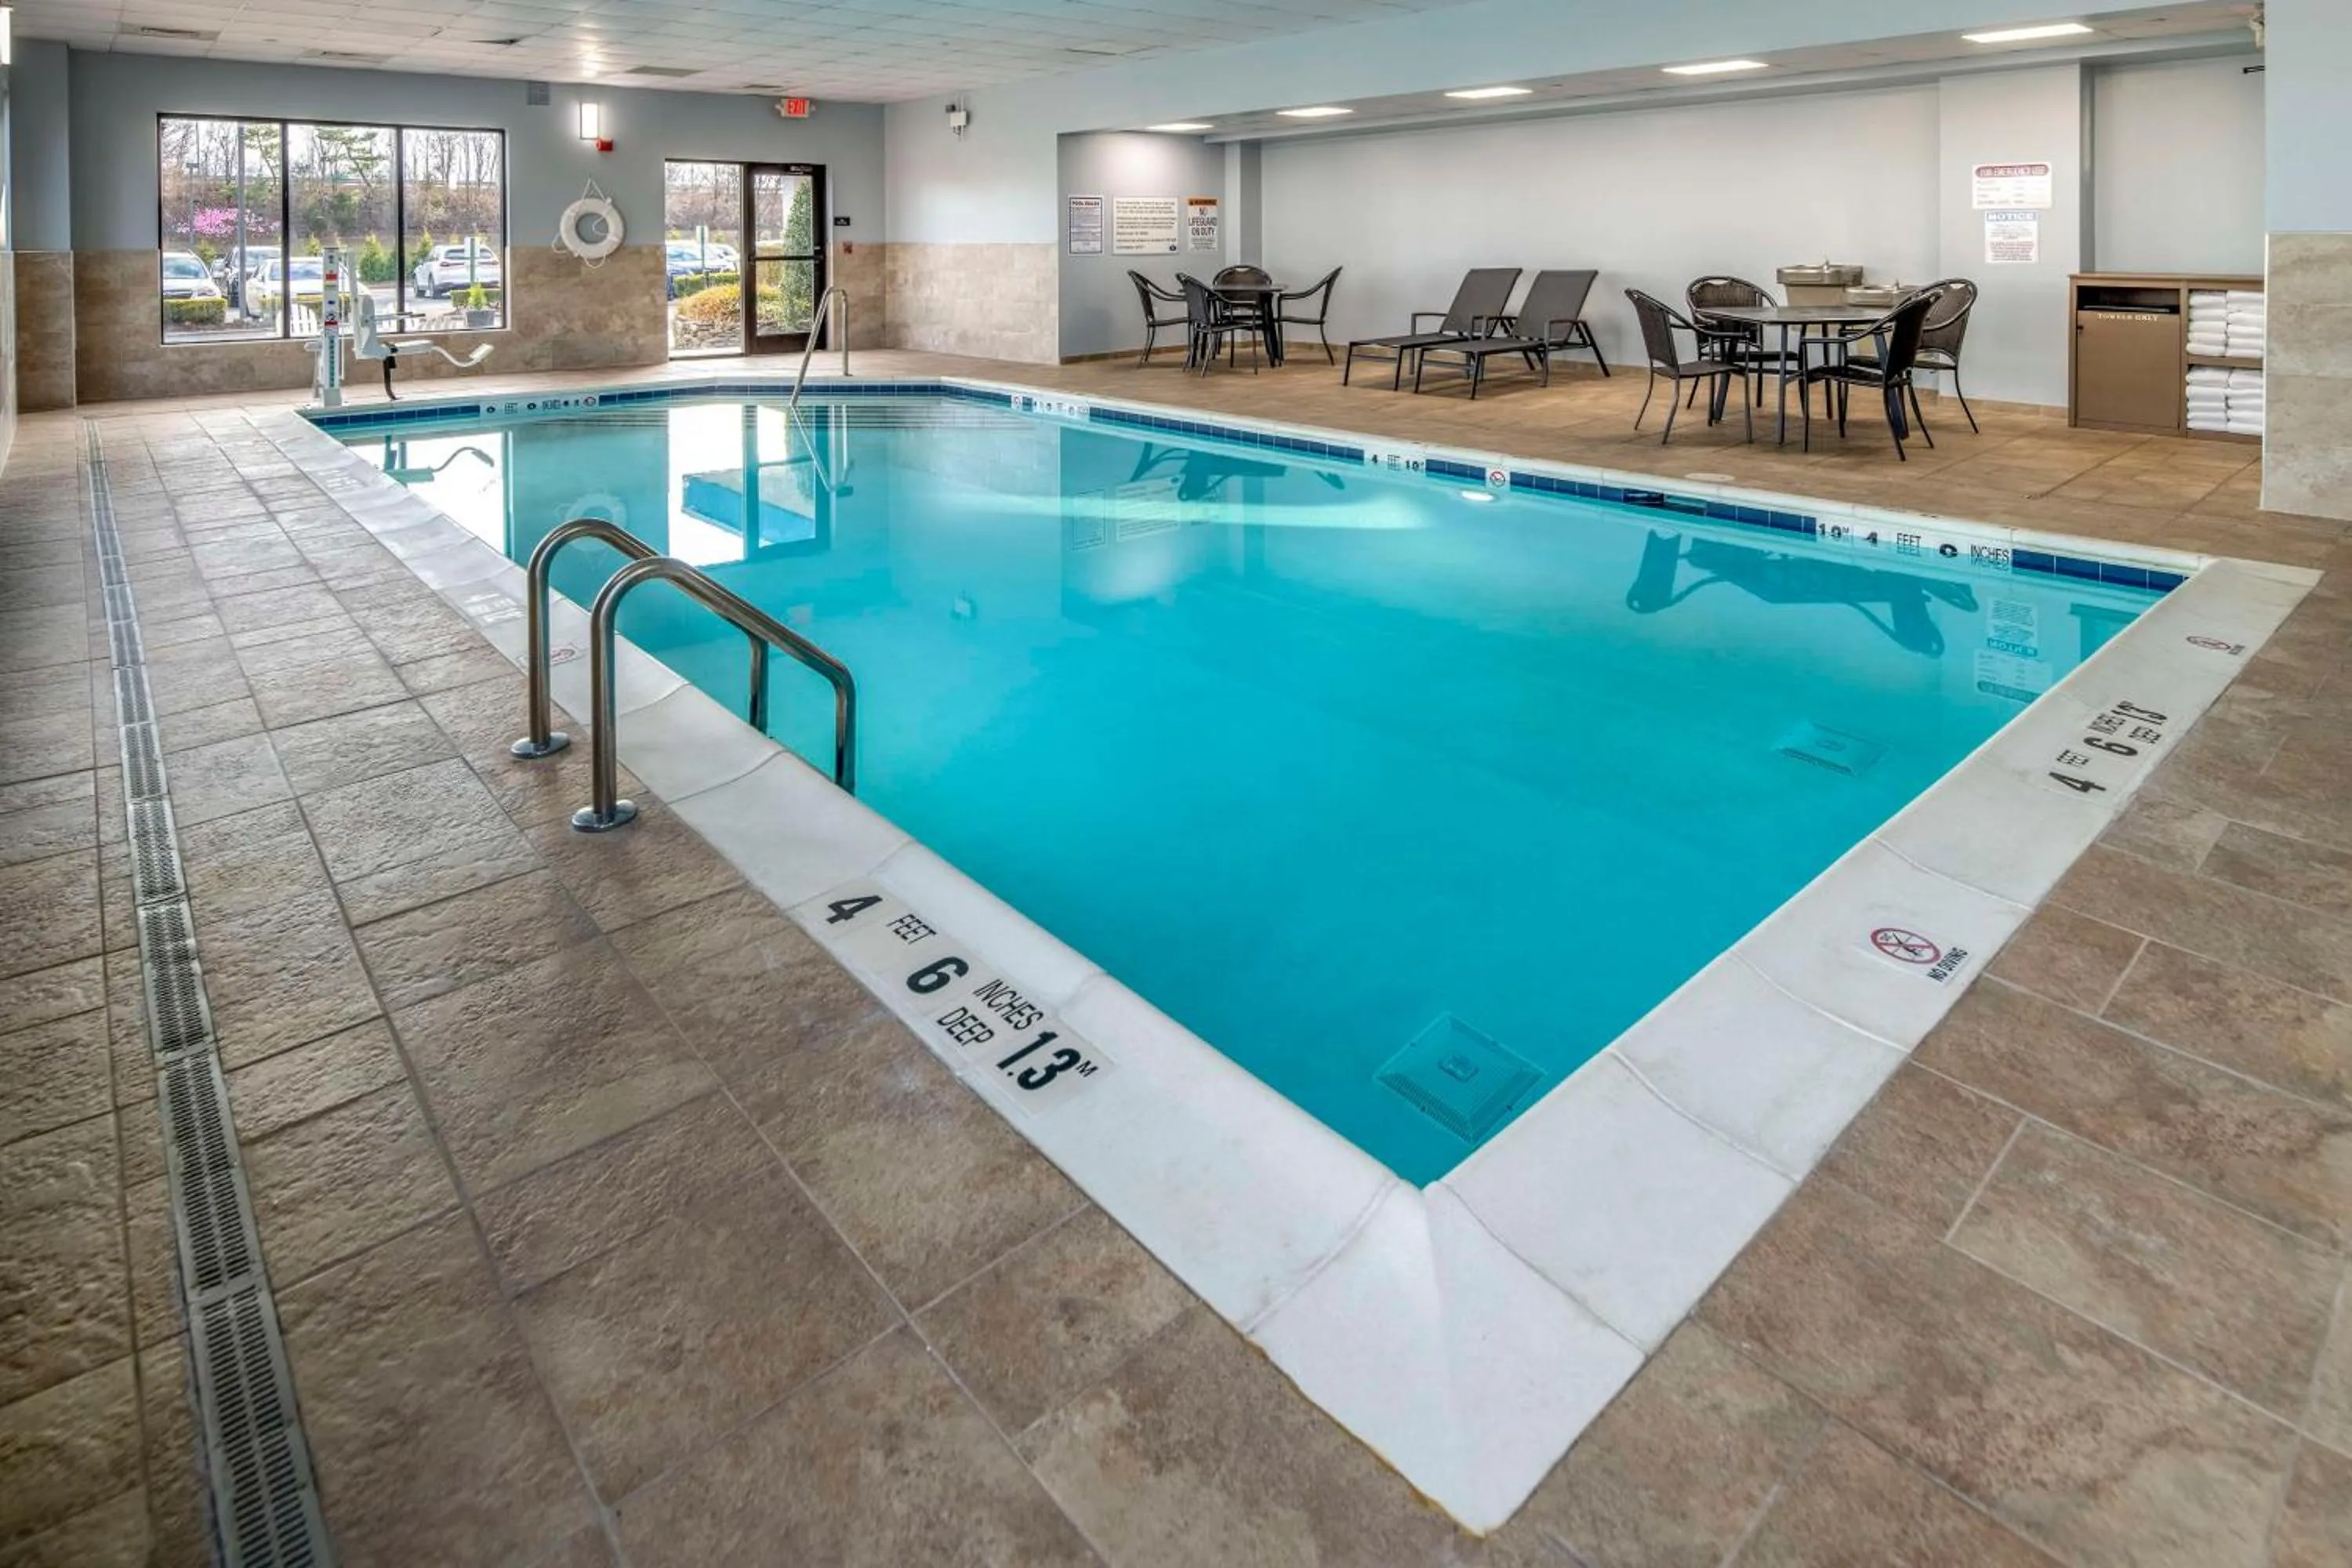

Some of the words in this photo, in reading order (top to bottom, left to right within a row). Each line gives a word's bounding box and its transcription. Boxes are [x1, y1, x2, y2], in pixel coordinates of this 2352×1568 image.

[787, 100, 807, 114] EXIT
[2049, 771, 2107, 793] 4
[2083, 736, 2138, 757] 6
[826, 895, 883, 924] 4
[886, 913, 938, 946] FEET
[906, 956, 969, 994] 6
[972, 978, 1045, 1031] INCHES
[935, 1005, 995, 1047] DEEP
